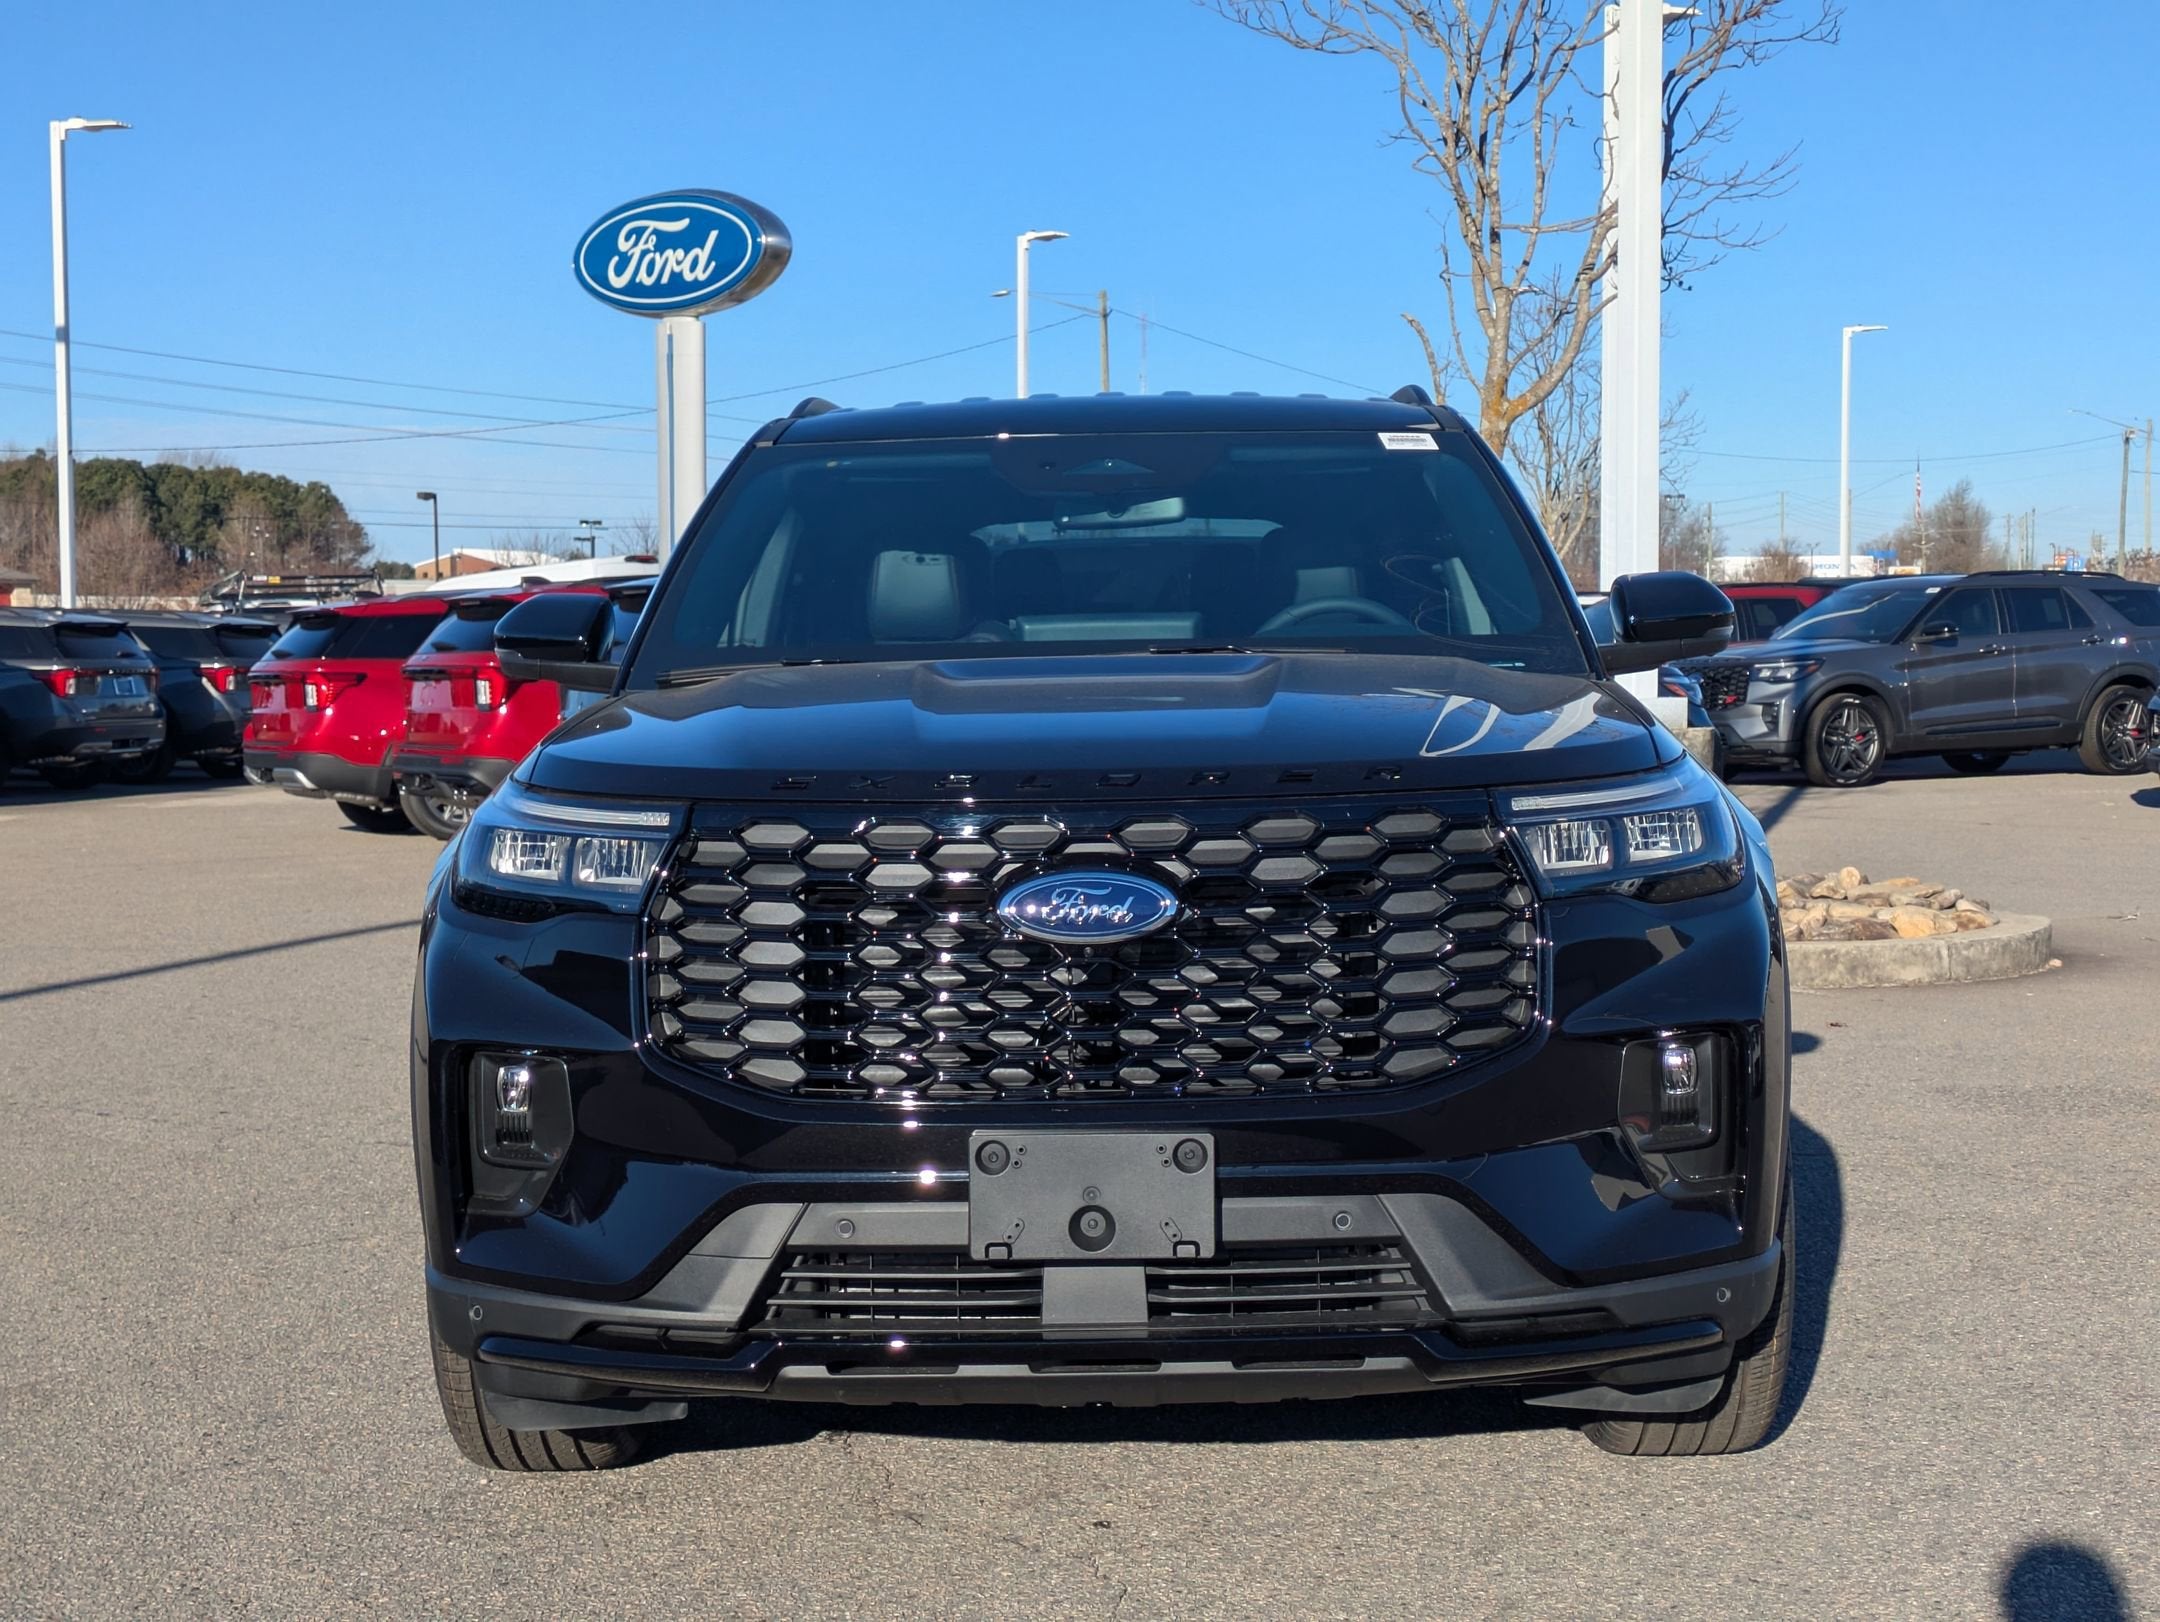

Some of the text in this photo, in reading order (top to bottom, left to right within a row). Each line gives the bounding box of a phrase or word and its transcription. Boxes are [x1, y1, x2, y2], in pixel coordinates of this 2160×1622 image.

[607, 217, 719, 289] Ford
[771, 767, 1402, 789] EXPLORER
[1041, 886, 1135, 926] Ford
